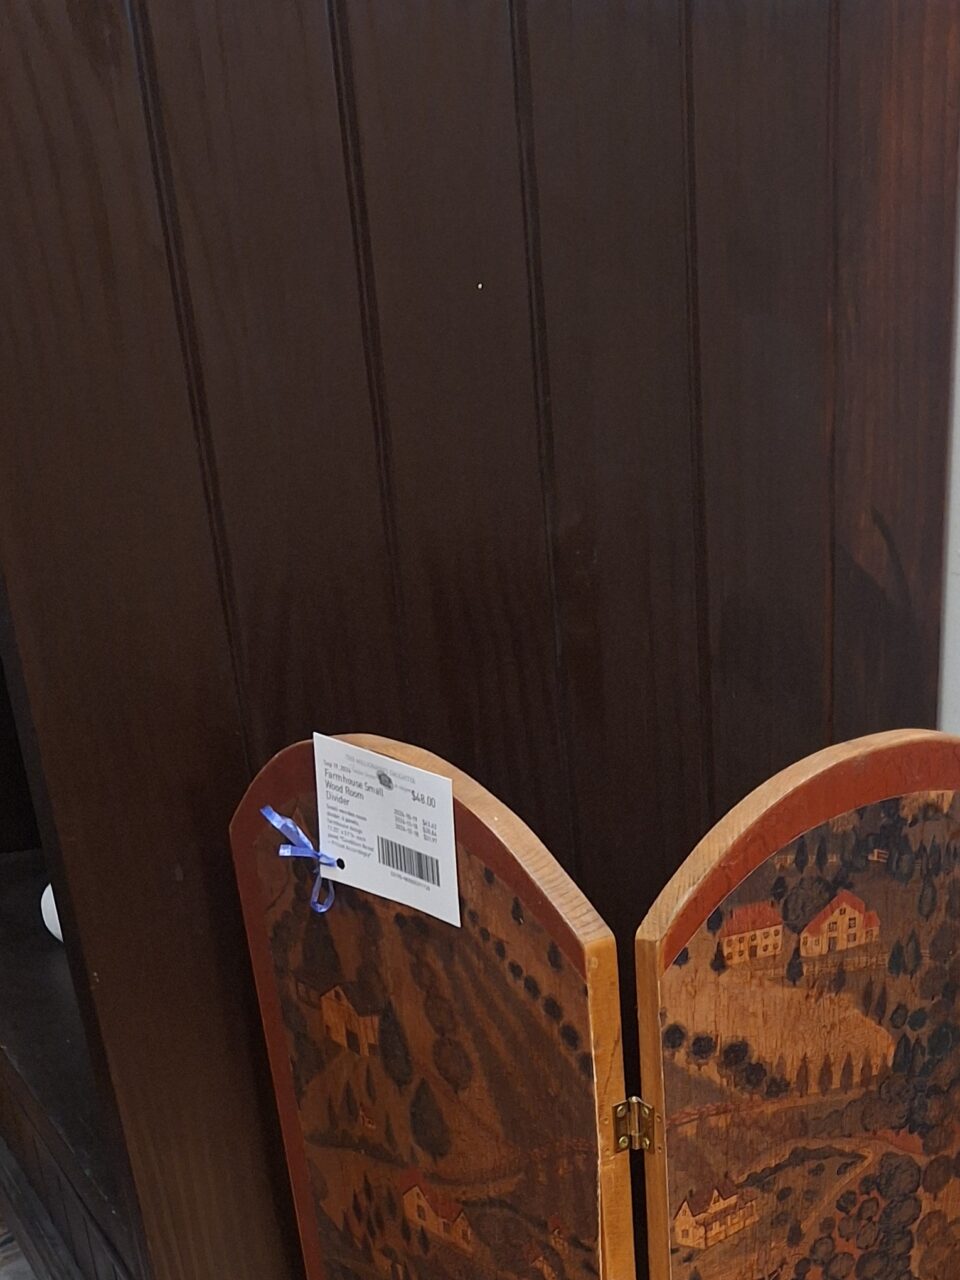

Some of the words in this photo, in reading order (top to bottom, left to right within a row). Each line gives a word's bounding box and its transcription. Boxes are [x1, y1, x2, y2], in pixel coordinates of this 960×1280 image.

[324, 768, 364, 790] Farmhouse
[364, 781, 384, 797] Small
[325, 780, 345, 795] Wood
[345, 787, 365, 801] Room
[326, 792, 350, 807] Divider
[411, 789, 436, 809] $48.00
